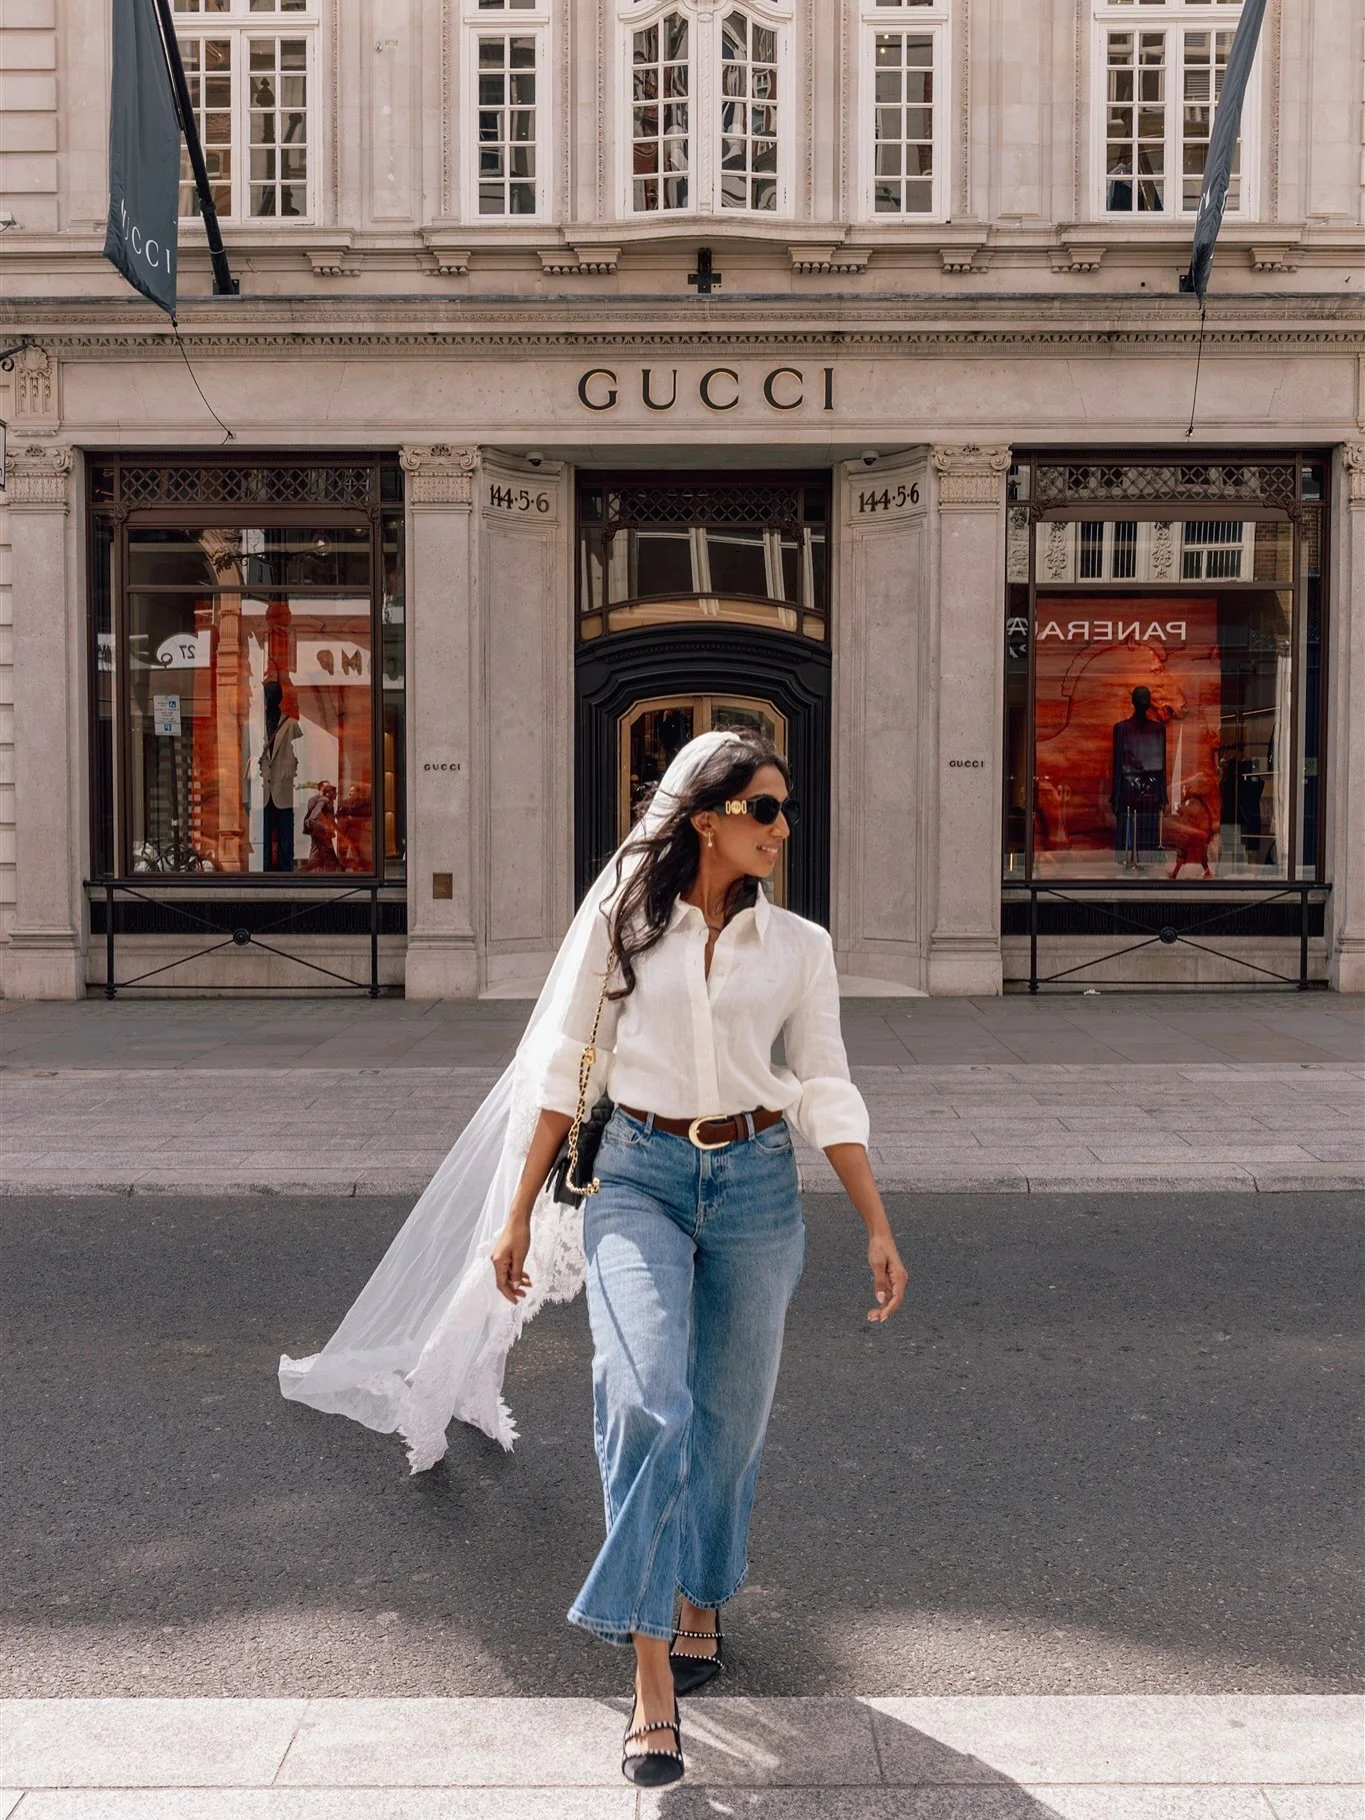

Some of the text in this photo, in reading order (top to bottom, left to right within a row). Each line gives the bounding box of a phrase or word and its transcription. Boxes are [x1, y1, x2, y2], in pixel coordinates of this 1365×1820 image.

[577, 367, 834, 411] GUCCI
[424, 763, 461, 771] GUCCI
[949, 760, 984, 768] GUCCI
